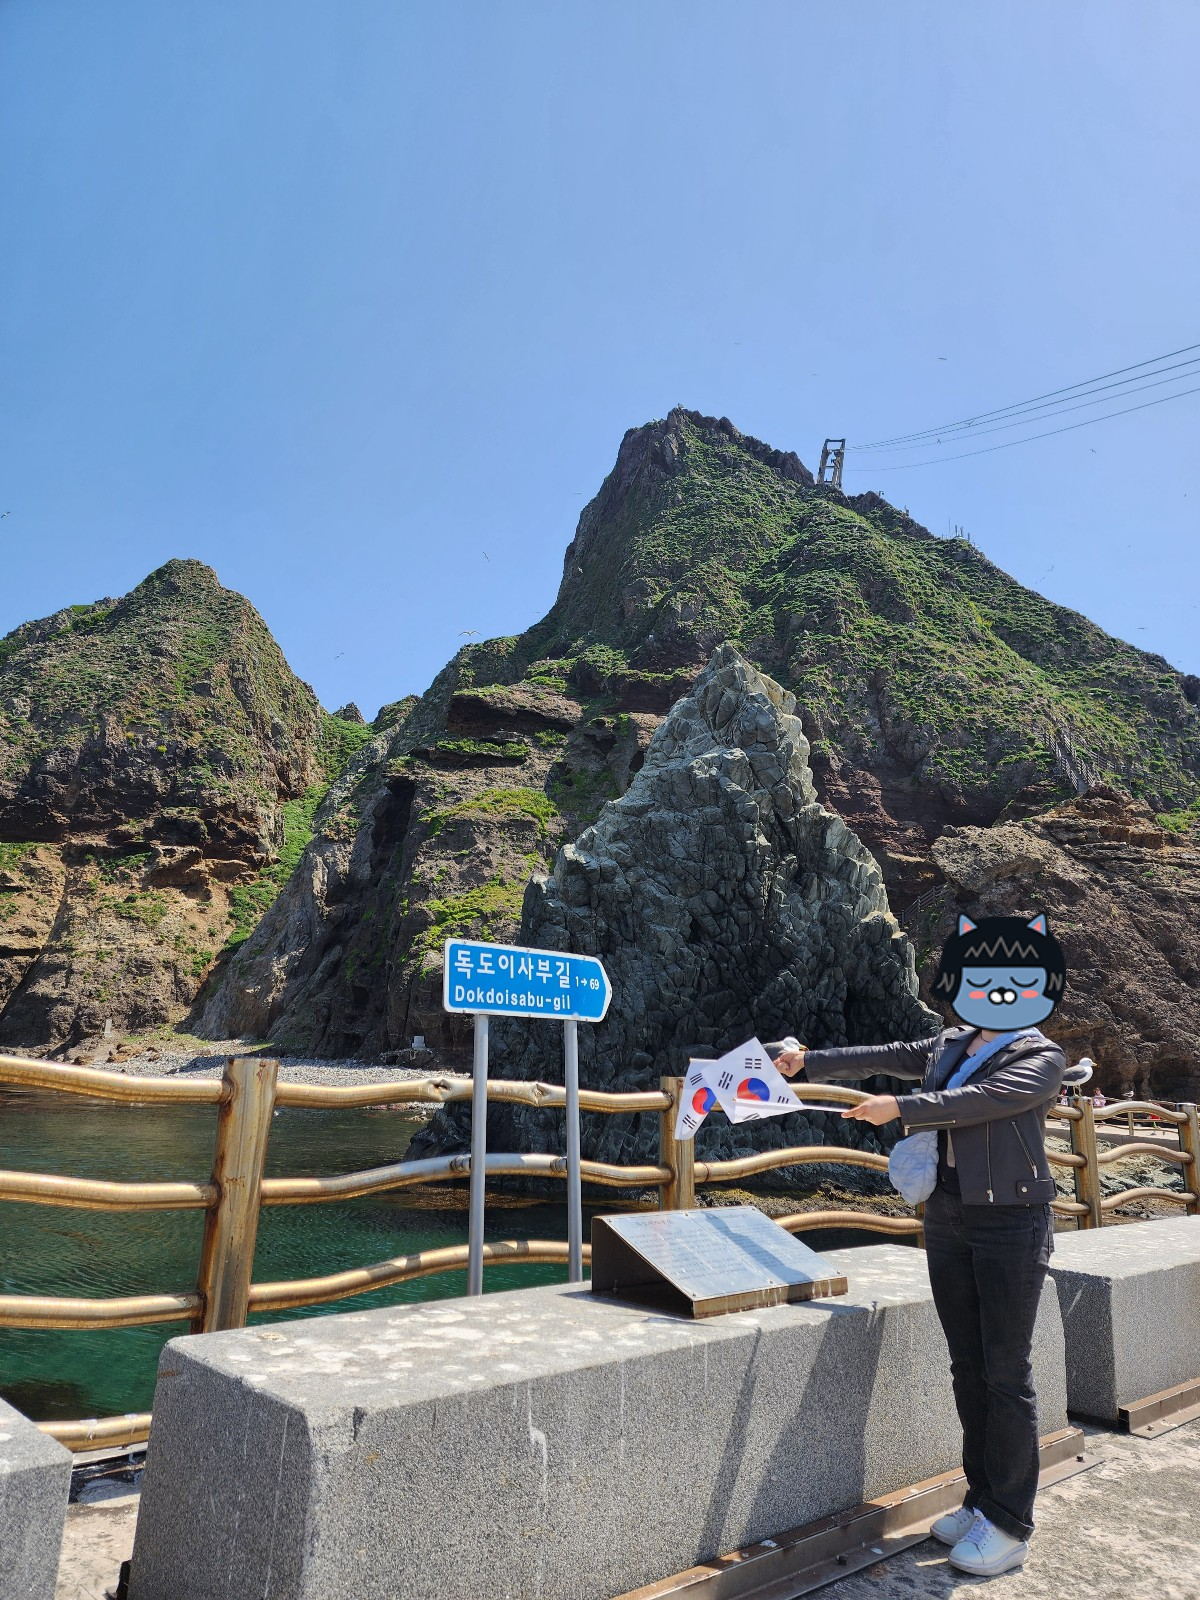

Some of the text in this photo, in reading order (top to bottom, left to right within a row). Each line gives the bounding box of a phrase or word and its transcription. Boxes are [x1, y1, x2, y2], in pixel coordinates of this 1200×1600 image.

[454, 950, 571, 989] 독도이사부길
[575, 976, 600, 990] 1 69
[455, 985, 571, 1011] Dokdoisabu-gil
